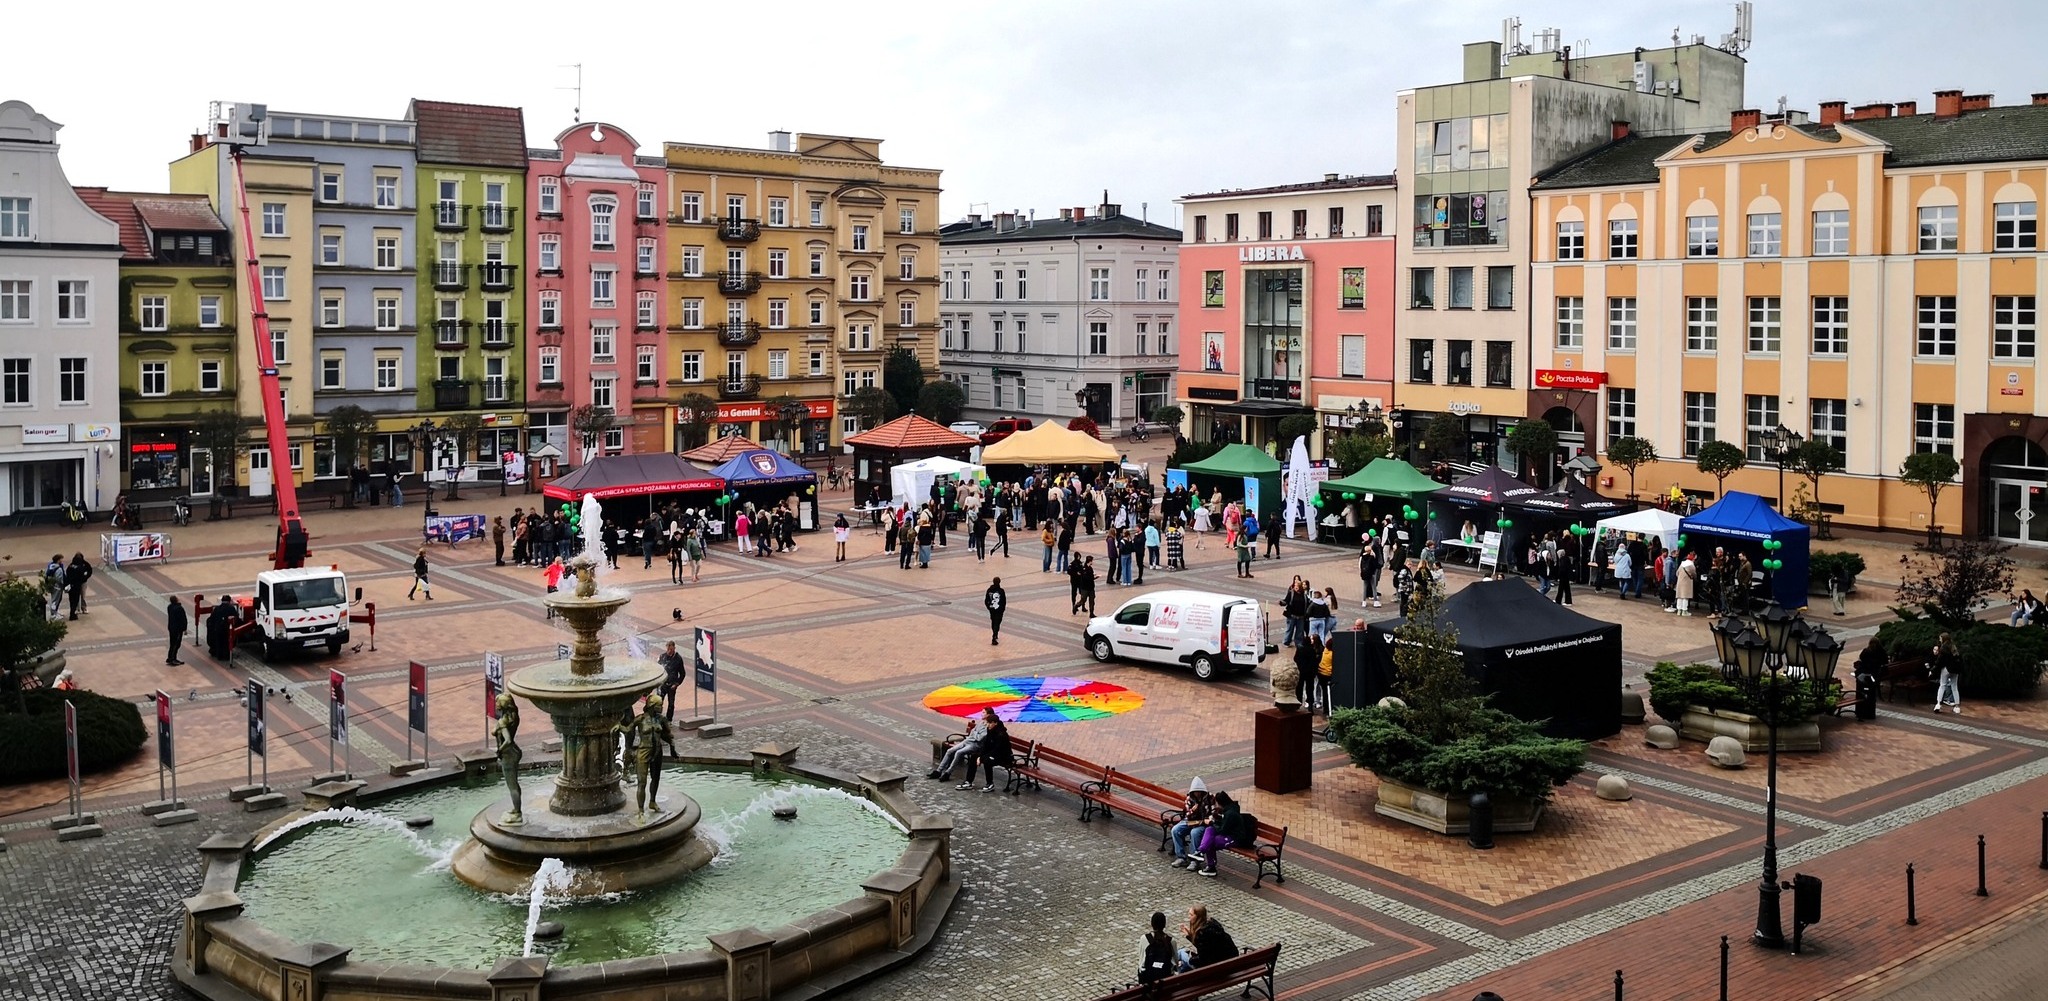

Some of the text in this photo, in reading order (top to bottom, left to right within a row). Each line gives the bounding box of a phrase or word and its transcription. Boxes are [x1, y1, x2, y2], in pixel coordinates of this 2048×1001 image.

[1239, 246, 1305, 262] LIBERA
[1556, 375, 1594, 384] Poczta Polska
[730, 407, 761, 417] Gemini
[1448, 400, 1482, 413] żabka
[89, 429, 106, 438] LOTTO
[591, 488, 625, 497] CHOTNICZA
[676, 482, 711, 490] CHOJNICACH
[1450, 485, 1493, 497] WINDEX
[1503, 487, 1537, 497] WINDEX
[1525, 499, 1569, 509] WINDEX
[1580, 501, 1616, 509] WINDEX
[1154, 617, 1179, 629] Catering
[1515, 648, 1534, 656] Ośrodek
[1534, 643, 1558, 653] Profilaktyki
[1558, 638, 1579, 648] Rodzinnej
[1582, 635, 1603, 644] Chojnicach
